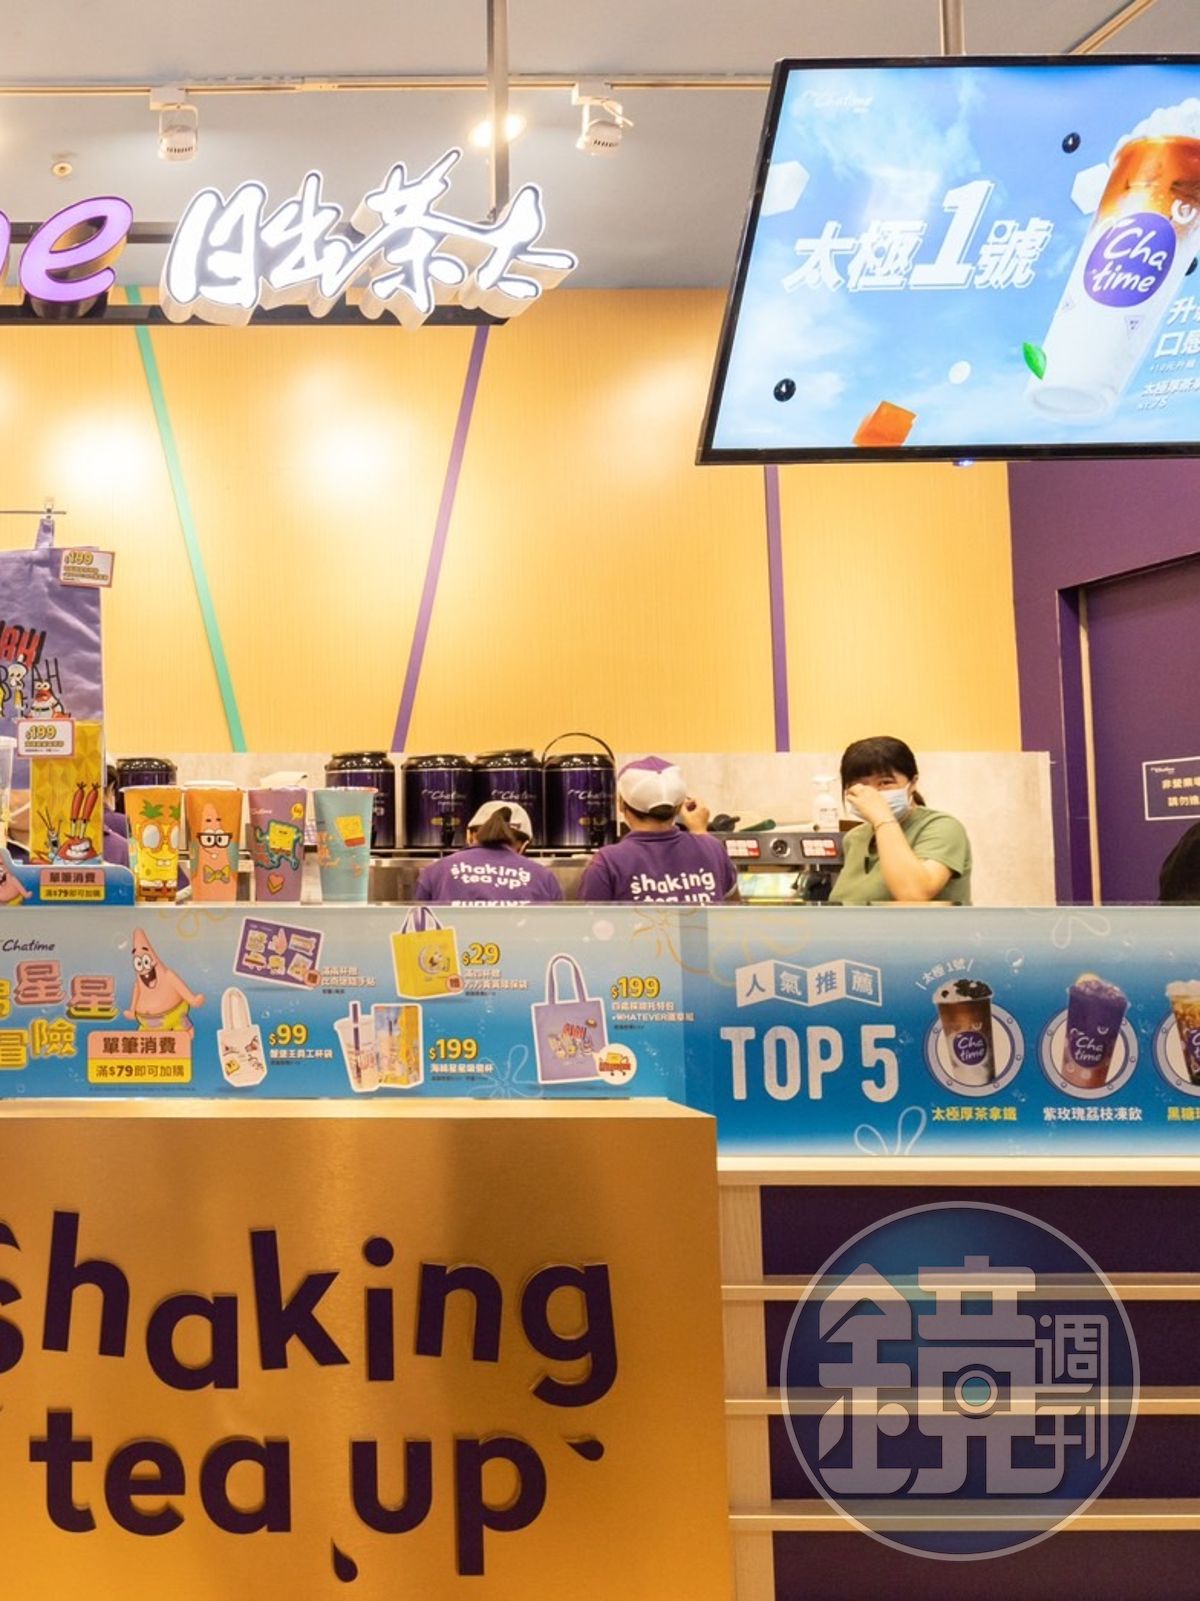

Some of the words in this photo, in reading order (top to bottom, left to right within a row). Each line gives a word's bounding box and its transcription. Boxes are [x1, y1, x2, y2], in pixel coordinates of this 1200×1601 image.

[162, 146, 578, 320] 日出茶太
[781, 180, 1053, 292] 太極1號
[1103, 225, 1168, 269] Cha
[1090, 263, 1156, 294] time
[1166, 295, 1200, 326] 升
[25, 725, 58, 740] $199
[451, 862, 532, 882] shaking
[460, 874, 492, 885] tea
[497, 876, 523, 890] up
[631, 871, 716, 895] shaking
[2, 938, 56, 952] Chatime
[462, 942, 501, 966] $29
[611, 975, 661, 1000] $199
[746, 968, 875, 997] 人氣推薦
[102, 1035, 178, 1056] 單筆消費
[268, 1023, 308, 1046] $99
[957, 1035, 985, 1050] Cha
[1075, 1036, 1104, 1052] Cha
[429, 1038, 479, 1061] $199
[959, 1047, 986, 1060] time
[1073, 1049, 1104, 1063] time
[95, 1062, 186, 1079] 滿$79即可加購
[720, 1024, 844, 1102] TOP
[859, 1024, 900, 1103] 5
[931, 1106, 1018, 1121] 太極厚茶拿鐵
[1042, 1106, 1143, 1121] 紫玫瑰荔枝凍飲
[29, 1407, 292, 1537] tea
[350, 1434, 547, 1577] up
